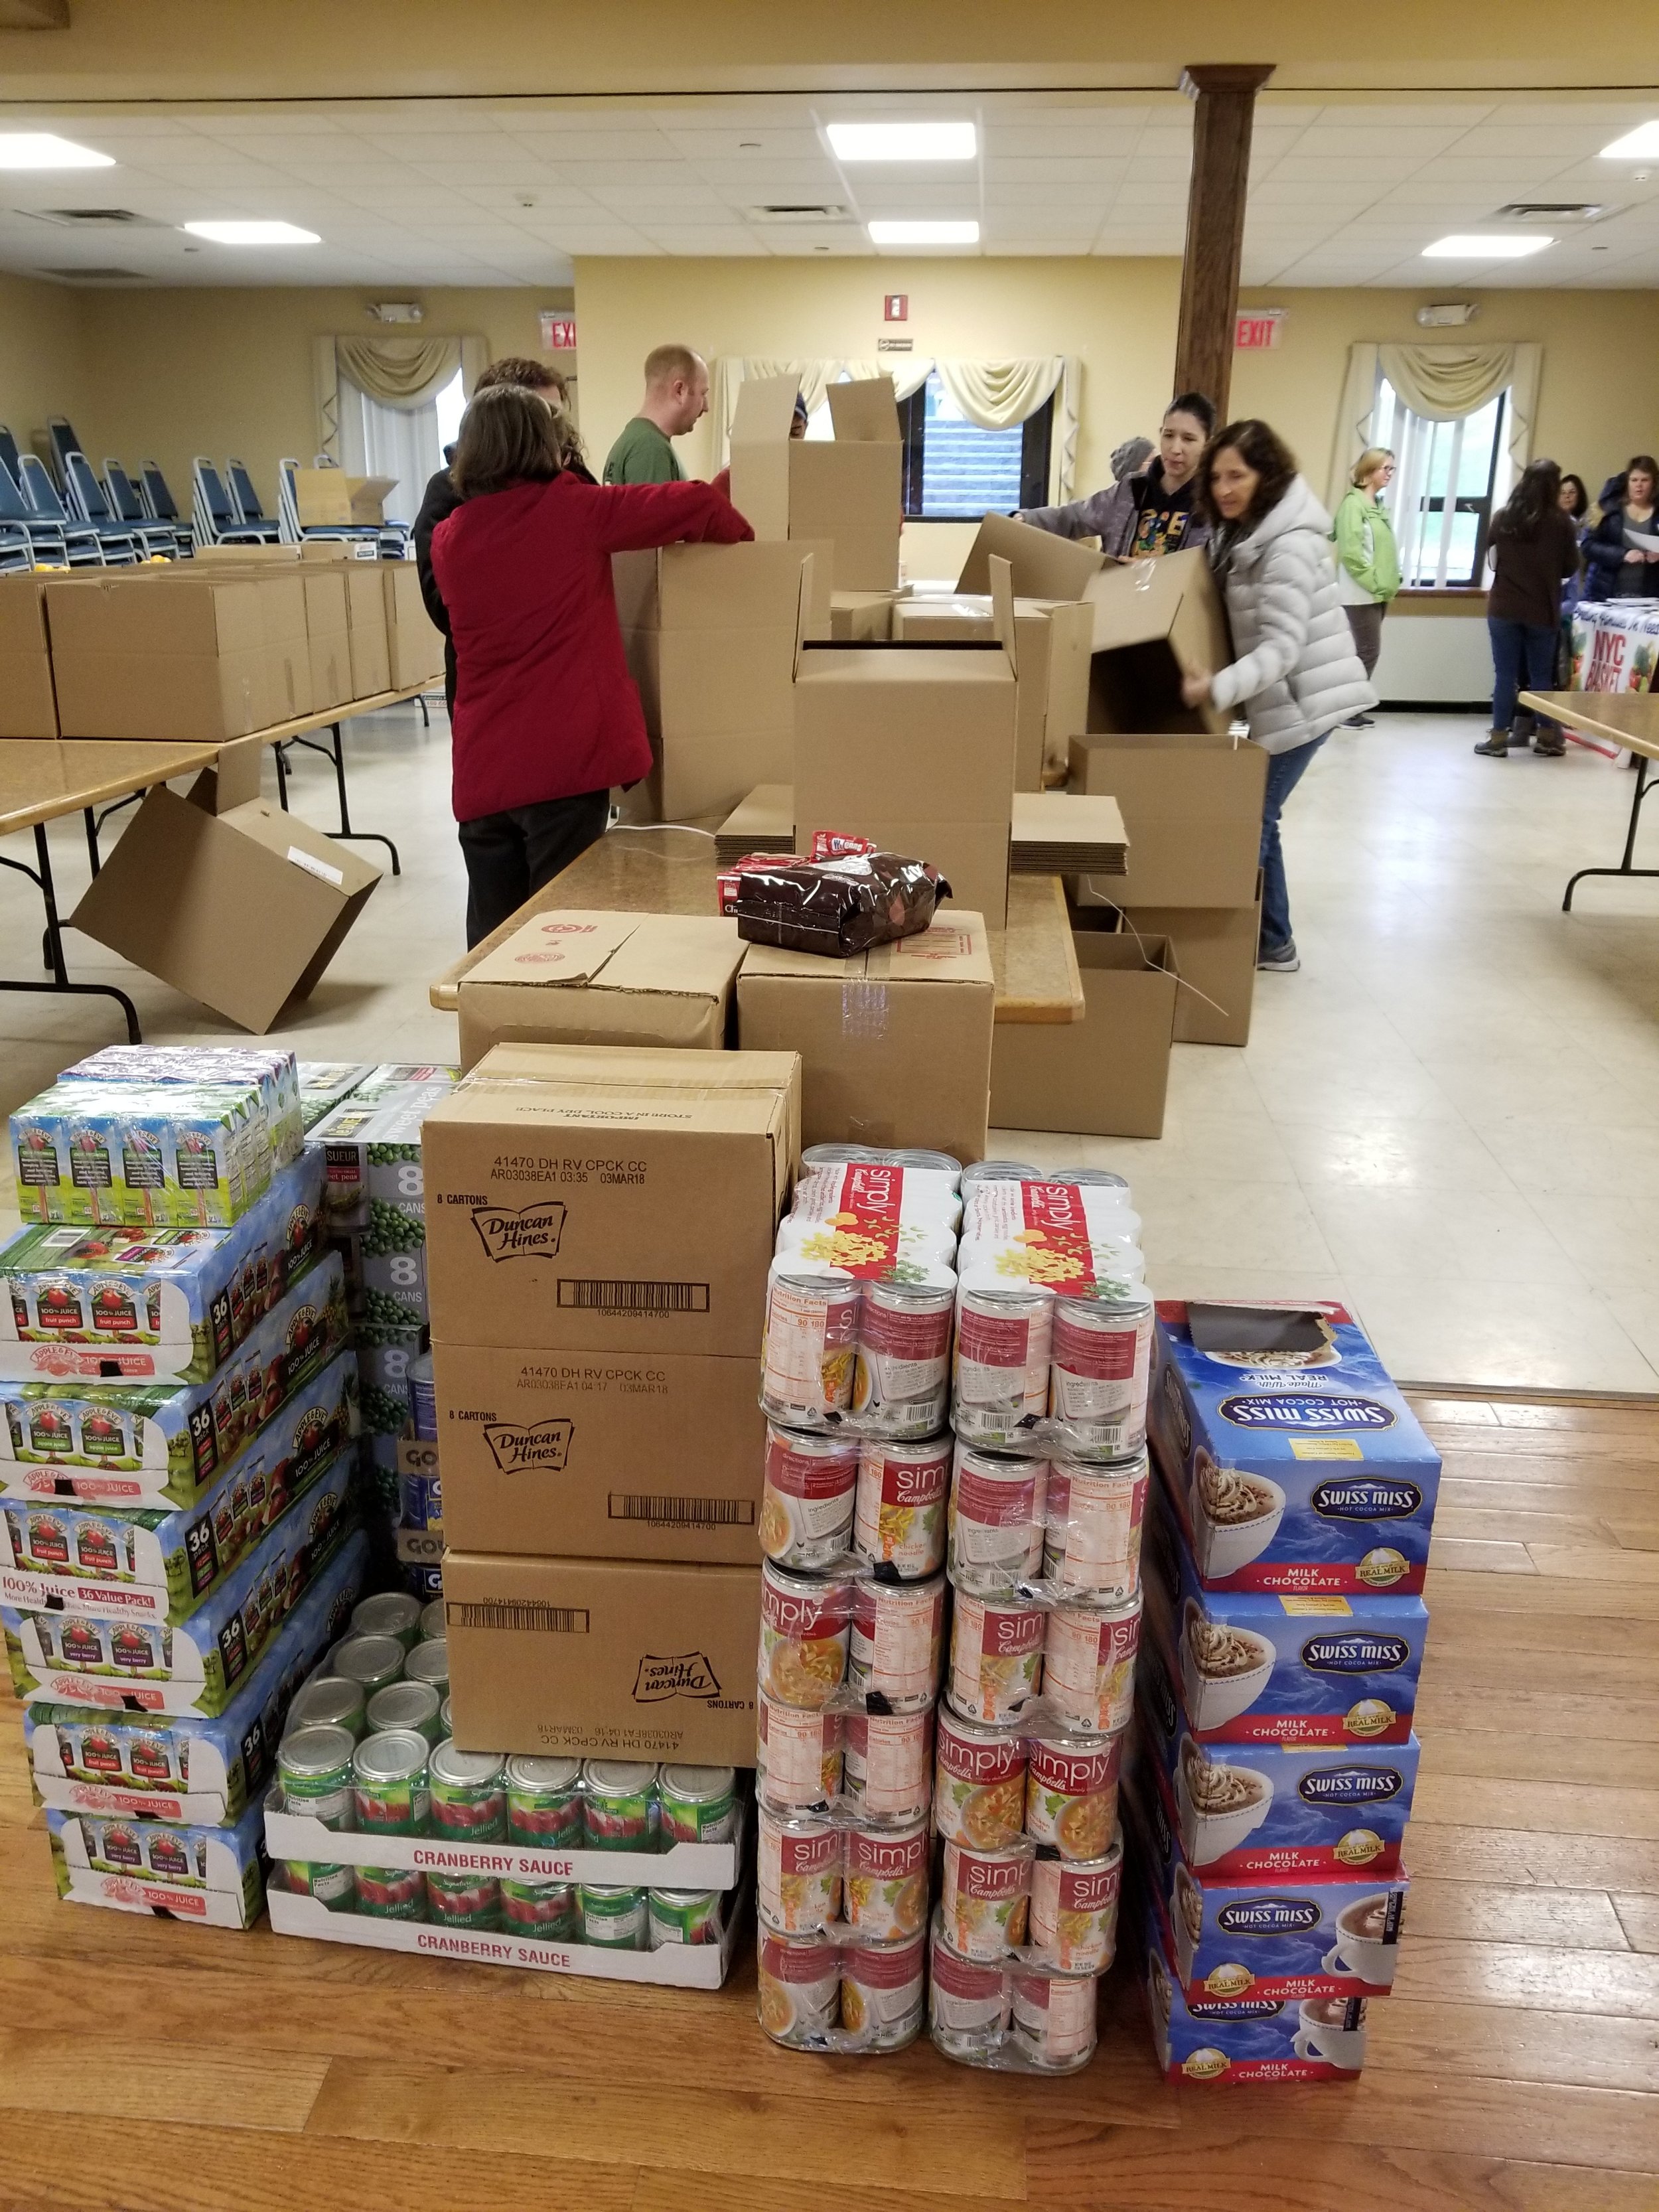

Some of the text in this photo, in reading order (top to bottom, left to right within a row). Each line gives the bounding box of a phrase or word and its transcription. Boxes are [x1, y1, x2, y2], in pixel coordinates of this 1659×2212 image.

[553, 323, 576, 347] EXI
[1237, 321, 1274, 346] EXIT
[1593, 630, 1626, 665] NYC
[383, 1086, 441, 1140] sweet peas
[327, 1151, 357, 1161] SUEUR
[494, 1157, 647, 1172] 41470 DH RV CPCK CC
[398, 1166, 424, 1195] 8
[490, 1169, 644, 1185] AR03038EA1 03:35 03MAR18
[437, 1195, 488, 1205] 8 CARTONS
[857, 1169, 895, 1213] simply
[398, 1203, 425, 1214] CANS
[1041, 1187, 1081, 1230] simply
[482, 1214, 553, 1235] Duncan
[301, 1239, 313, 1257] JUICE
[496, 1230, 549, 1250] Hines
[390, 1257, 417, 1285] 8
[394, 1291, 423, 1302] CANS
[774, 1287, 801, 1303] Nutrition
[213, 1297, 228, 1325] 36
[597, 1309, 670, 1319] 10644209414700
[304, 1337, 320, 1357] JUICE
[384, 1349, 409, 1378] 8
[521, 1367, 666, 1381] 41470 DH RV CPCK CC
[384, 1384, 408, 1394] CANS
[192, 1410, 210, 1437] 36
[459, 1412, 496, 1422] CARTONS
[1233, 1405, 1386, 1424] SWISS MISS
[313, 1438, 331, 1460] JUICE
[494, 1431, 561, 1450] Duncan
[508, 1447, 557, 1463] Hines
[782, 1453, 809, 1465] directions
[107, 1483, 133, 1493] JUICE
[808, 1497, 839, 1513] ingredients
[1319, 1490, 1413, 1507] SWISS MISS
[190, 1521, 210, 1552] 36
[1360, 1565, 1406, 1577] REAL MILK
[3, 1576, 75, 1598] 100% Juice
[5, 1592, 129, 1617] More Healthy
[82, 1589, 151, 1607] 36 Value Pack!
[222, 1618, 240, 1649] 36
[1308, 1645, 1402, 1661] SWISS MISS
[645, 1675, 711, 1692] Duncan
[707, 1700, 745, 1709] CARTONS
[244, 1725, 260, 1757] 36
[541, 1735, 680, 1749] 41470 DH RV CPCK CC
[938, 1730, 1015, 1775] simply
[1030, 1743, 1109, 1786] simply
[1029, 1763, 1066, 1790] Campbell's
[1305, 1776, 1395, 1794] SWISS MISS
[149, 1801, 174, 1809] JUICE
[470, 1820, 498, 1836] Jellied
[414, 1850, 573, 1876] CRANBERRY SAUCE
[175, 1895, 200, 1906] JUICE
[385, 1901, 414, 1915] Jellied
[443, 1914, 471, 1923] Jellied
[1224, 1909, 1314, 1925] SWISS MISS
[418, 1935, 571, 1967] CRANBERRY SAUCE
[1263, 1986, 1334, 1995] CHOCOLATE
